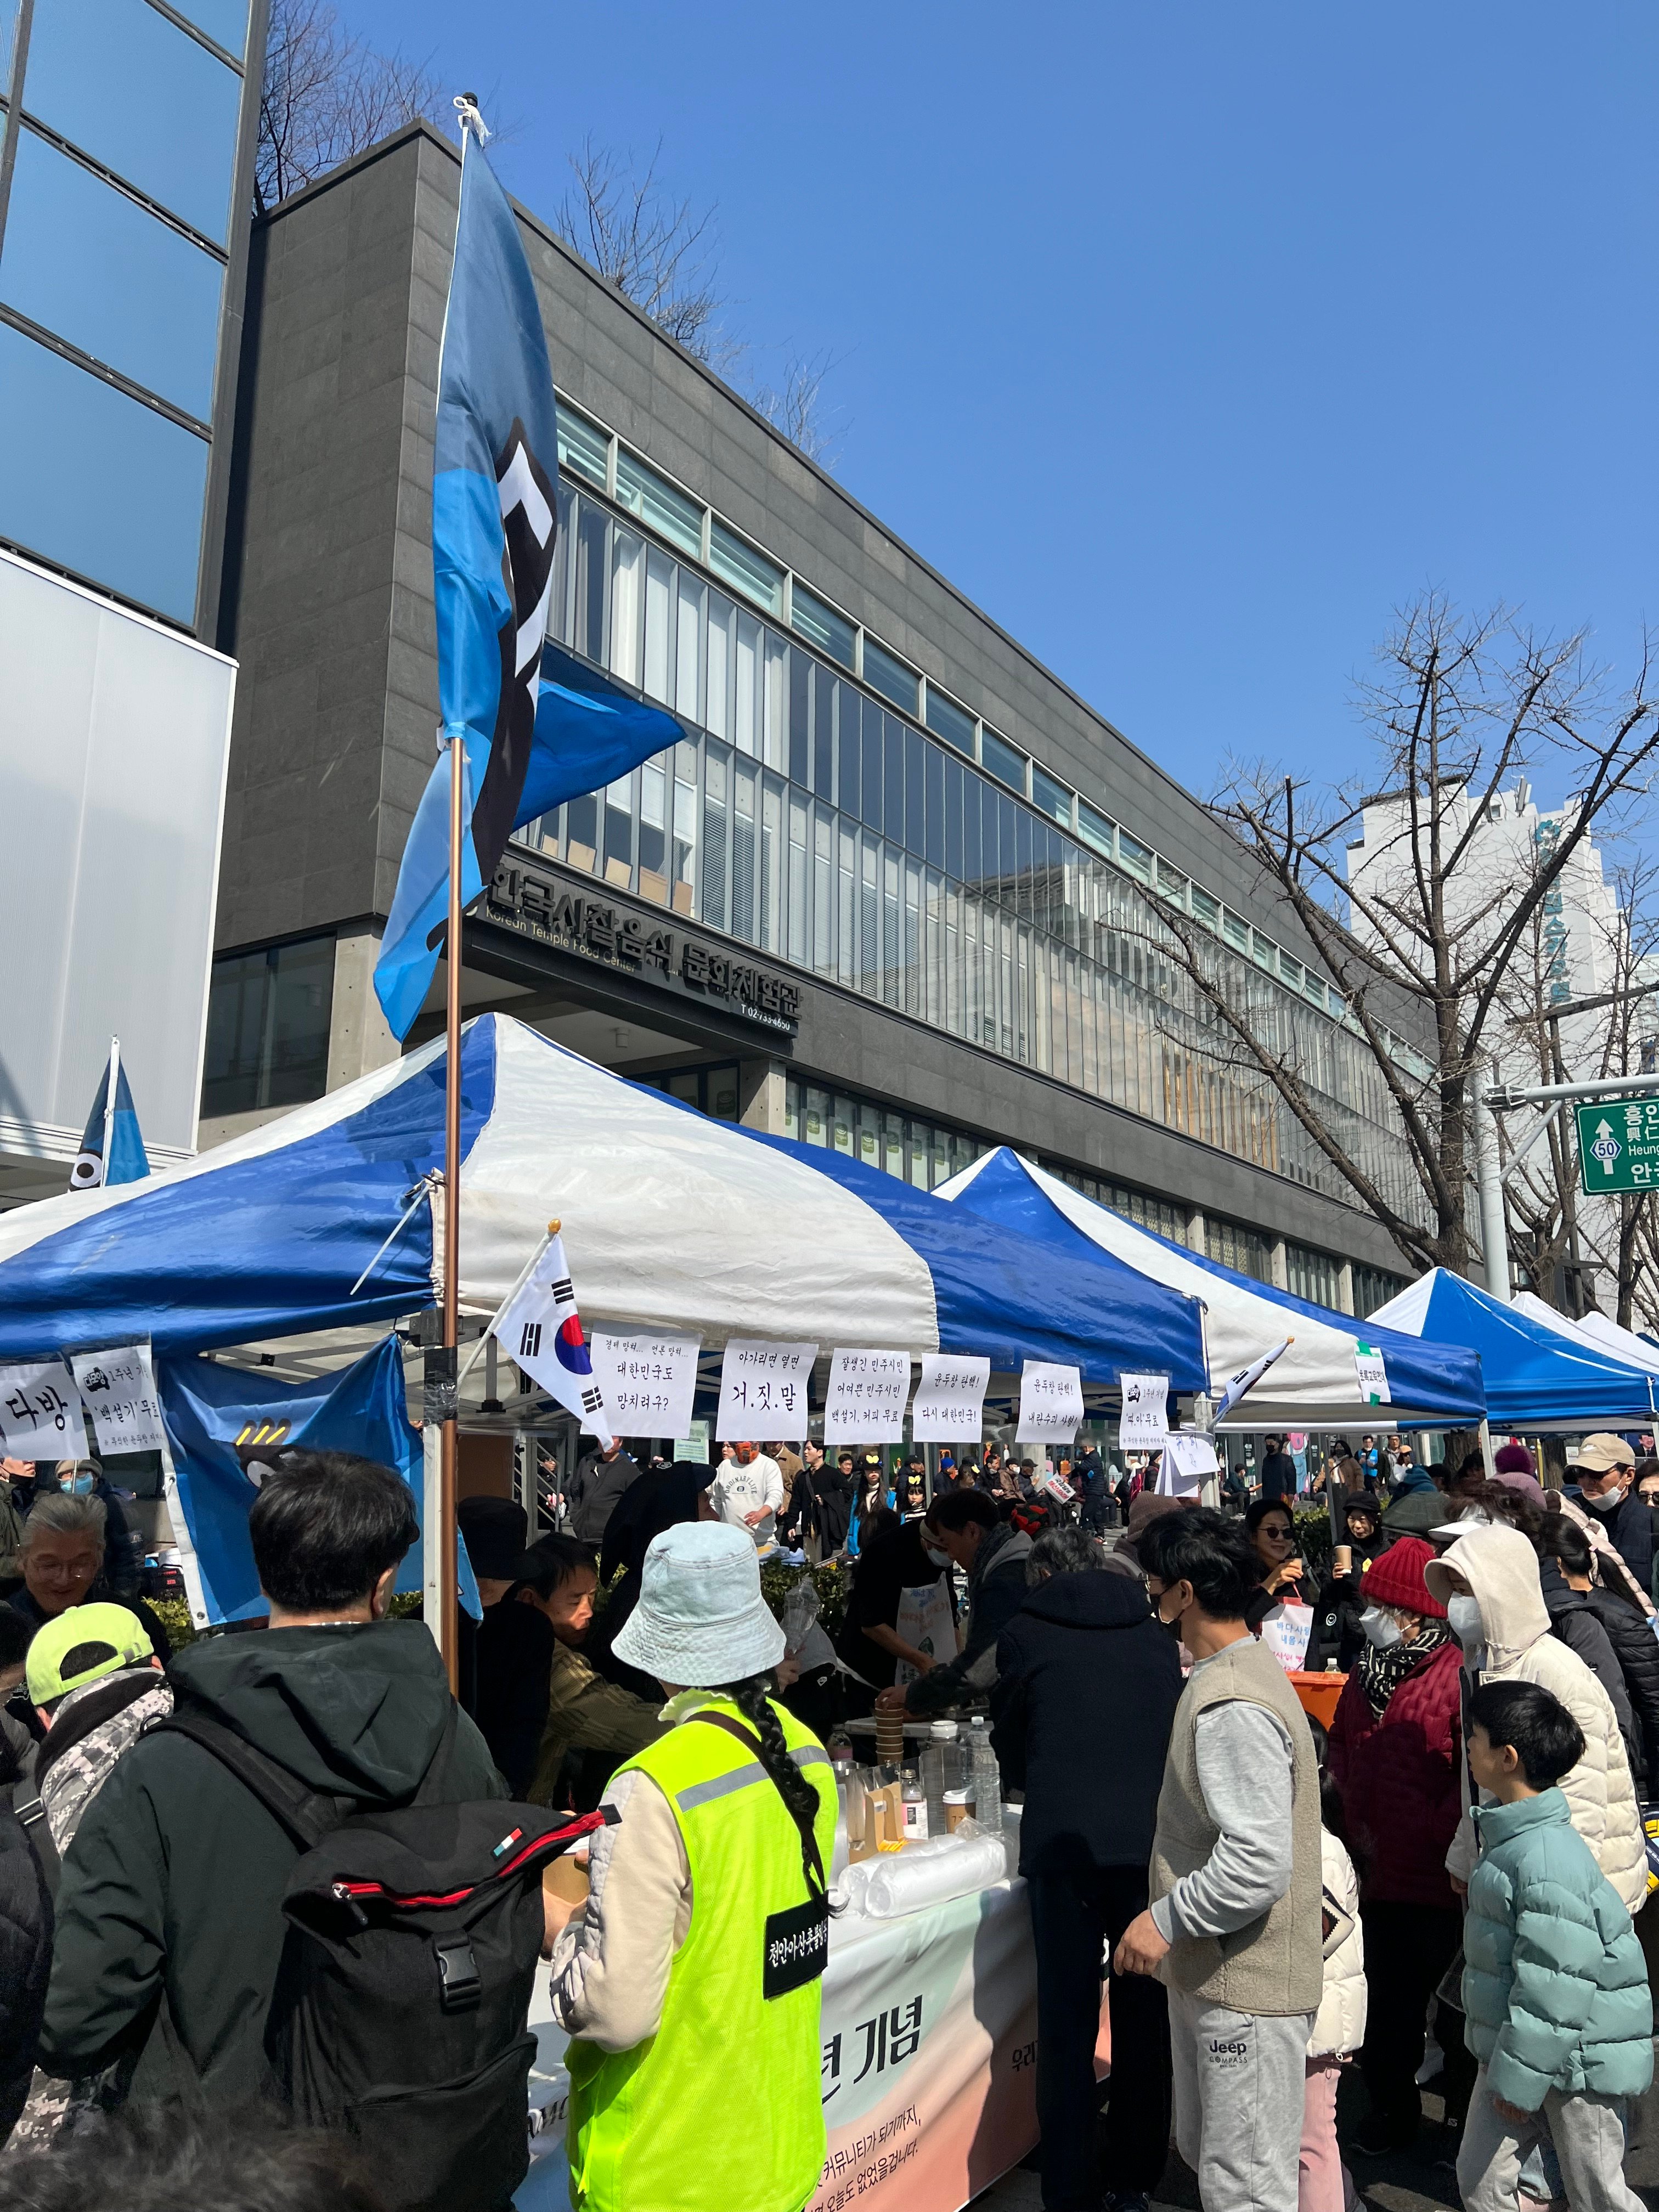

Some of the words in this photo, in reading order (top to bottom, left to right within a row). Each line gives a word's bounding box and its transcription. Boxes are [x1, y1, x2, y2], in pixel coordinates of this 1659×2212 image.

[486, 905, 527, 932] Korean
[531, 922, 569, 947] Temple
[573, 940, 600, 959] Food
[604, 949, 637, 973] Center
[682, 943, 804, 1019] 문화체험관
[741, 1004, 747, 1014] T
[748, 1007, 791, 1031] 02-733-4650
[1598, 1142, 1615, 1156] 50
[1631, 1161, 1659, 1184] 안
[606, 1339, 619, 1350] 경제
[652, 1345, 665, 1356] 언론
[739, 1351, 777, 1369] 아가리면
[781, 1354, 800, 1370] 열면
[841, 1357, 866, 1372] 잘생긴
[872, 1358, 903, 1373] 민주시민
[109, 1366, 134, 1381] 1주년
[617, 1361, 673, 1381] 대한민국도
[934, 1373, 958, 1389] 윤두창
[961, 1375, 980, 1389] 탄핵!
[1034, 1379, 1054, 1394] 윤두창
[1058, 1382, 1073, 1396] 탄핵!
[837, 1383, 863, 1397] 어여쁜
[867, 1384, 900, 1398] 민주시민
[1143, 1389, 1155, 1399] 1주년
[1156, 1389, 1164, 1399] 기념
[5, 1385, 69, 1431] 다방
[617, 1392, 669, 1412] 망치려구?
[832, 1409, 860, 1424] 백설기,
[863, 1408, 879, 1424] 커피
[882, 1409, 898, 1423] 무료
[922, 1407, 938, 1422] 다시
[941, 1408, 977, 1423] 대한민국!
[1029, 1412, 1058, 1426] 내란수괴
[1146, 1413, 1159, 1427] 무료
[853, 1994, 923, 2085] 기념
[1209, 2039, 1247, 2056] Jeep
[1012, 2040, 1039, 2072] 우리
[823, 2130, 876, 2180] 커뮤니티가
[878, 2104, 921, 2143] 되기까지,
[827, 2180, 855, 2212] 오늘도
[857, 2138, 918, 2195] 없었을겁니다.
